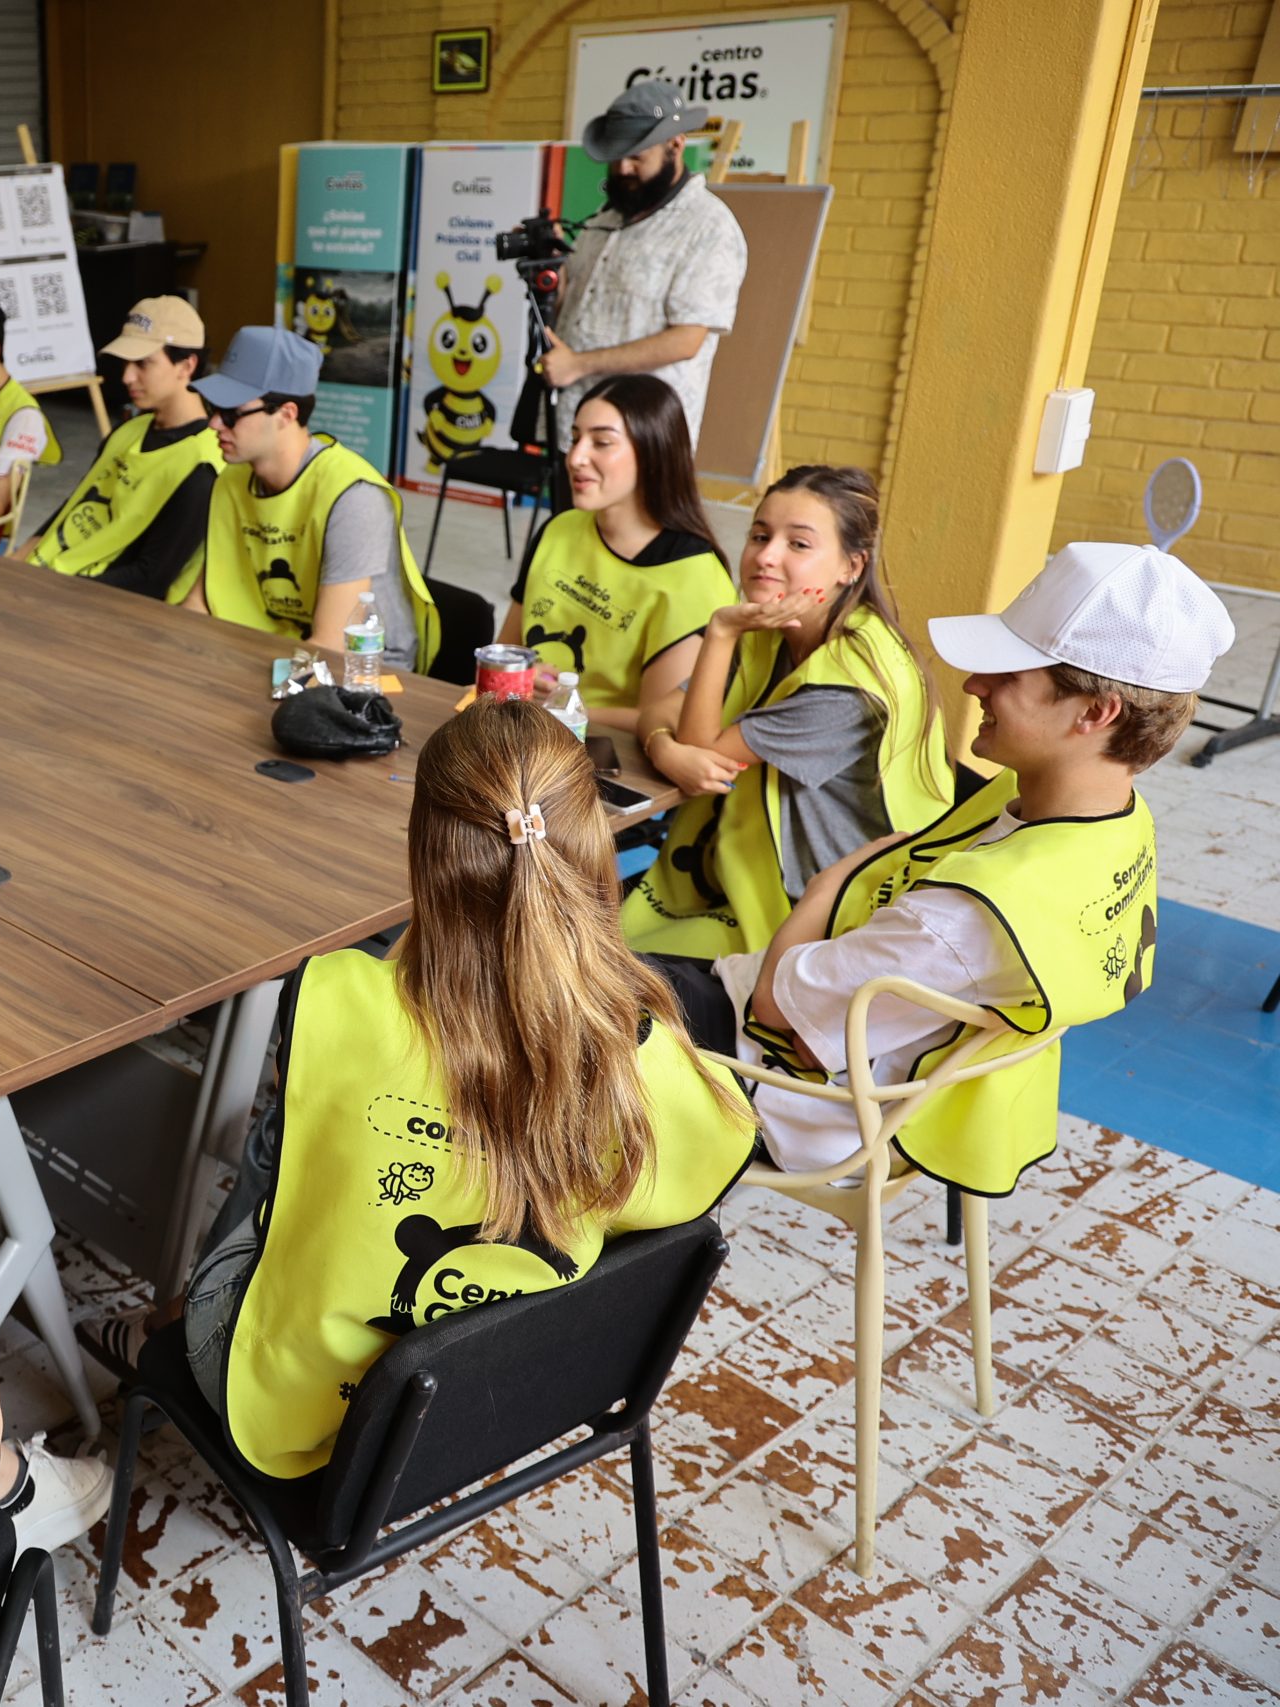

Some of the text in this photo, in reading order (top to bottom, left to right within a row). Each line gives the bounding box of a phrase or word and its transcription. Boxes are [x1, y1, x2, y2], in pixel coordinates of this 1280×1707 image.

[701, 46, 762, 62] centro
[449, 216, 493, 228] Civismo
[455, 415, 481, 428] Civil
[575, 575, 610, 602] Servicio
[555, 580, 612, 620] comunitario
